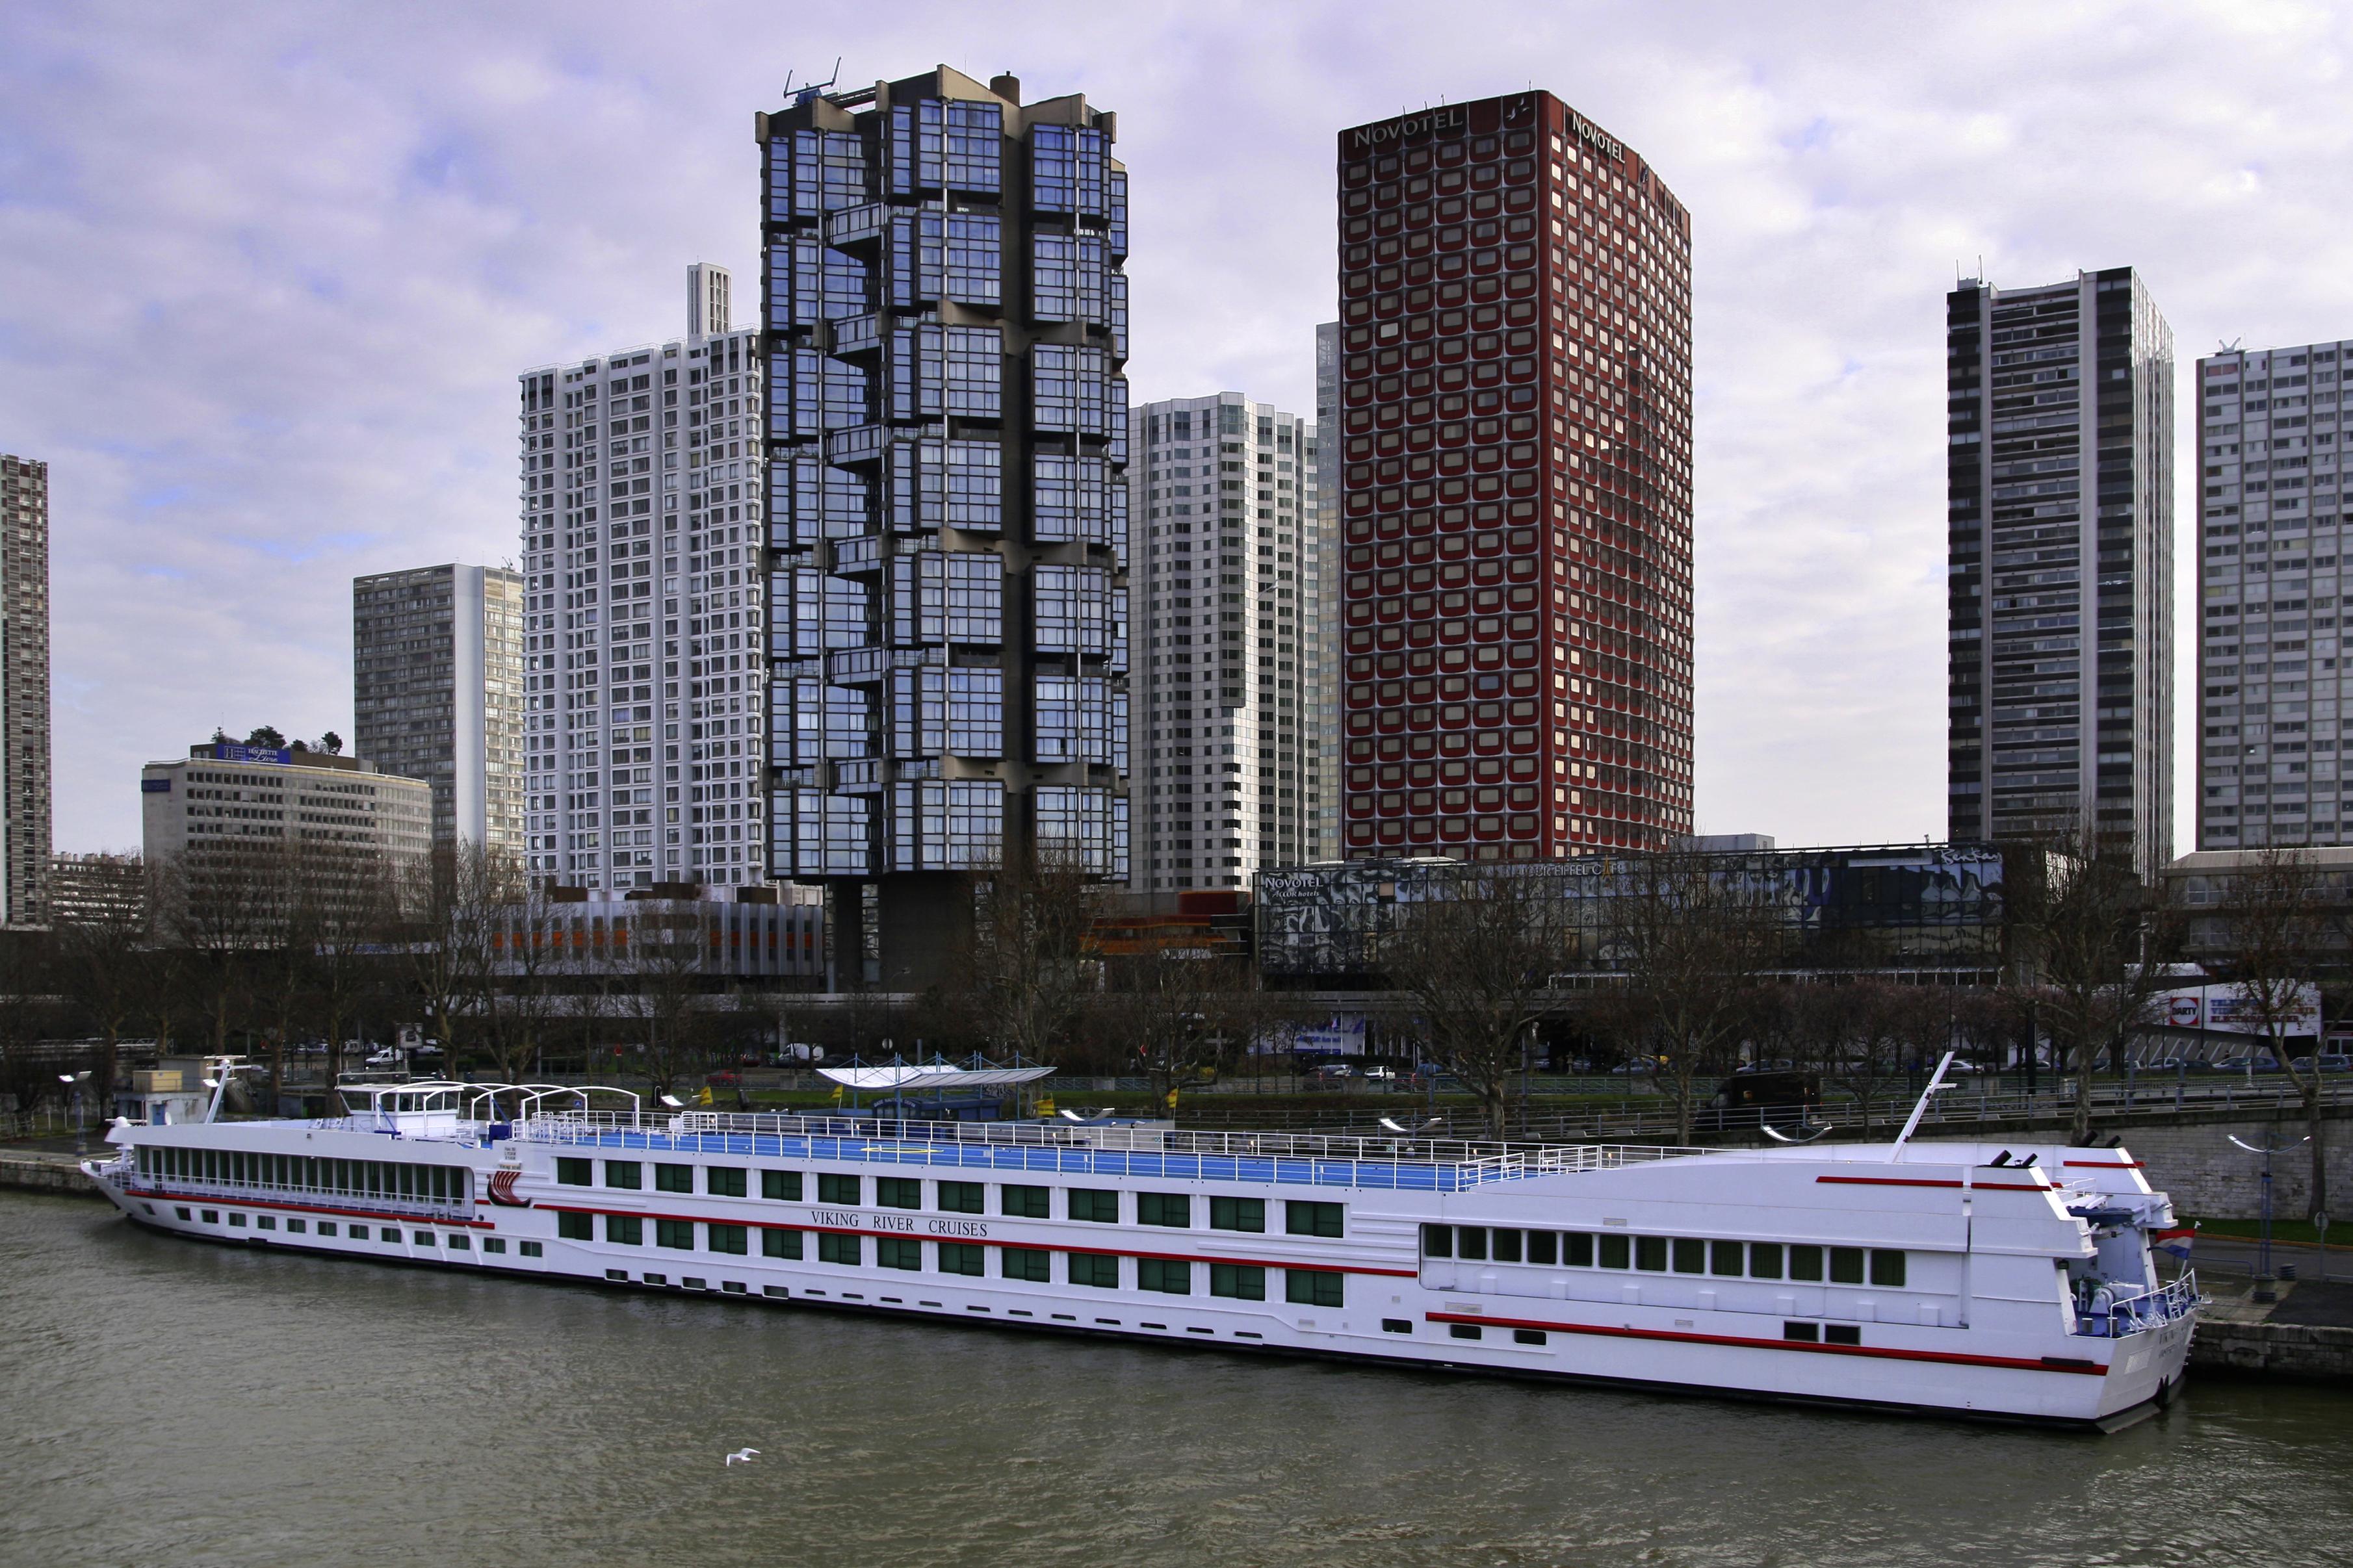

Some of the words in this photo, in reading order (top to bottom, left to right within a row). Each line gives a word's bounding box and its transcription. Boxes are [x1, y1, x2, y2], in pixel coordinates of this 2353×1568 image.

[1354, 109, 1463, 148] NOVOTEL
[1572, 111, 1625, 164] NOVOTEL
[1265, 877, 1323, 888] NOVOTEL
[1555, 864, 1588, 876] EIFFEL
[811, 1211, 859, 1227] VIKING
[873, 1215, 914, 1231] RIVER
[929, 1219, 987, 1237] CRUISES
